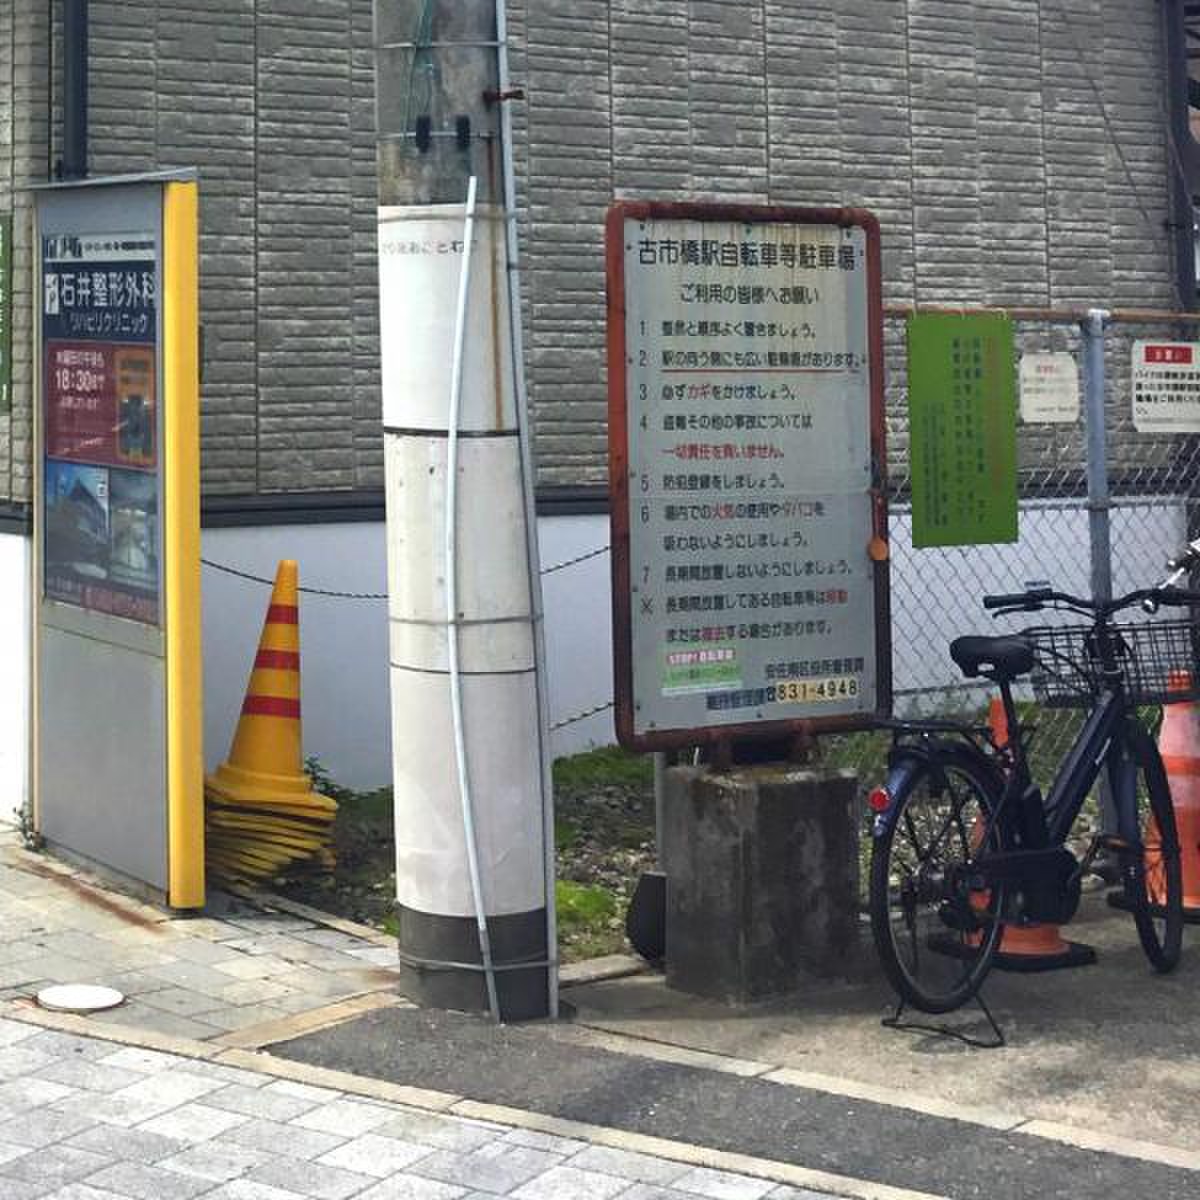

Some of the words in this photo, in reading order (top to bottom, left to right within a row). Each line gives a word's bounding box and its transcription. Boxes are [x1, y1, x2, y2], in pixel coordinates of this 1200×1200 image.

[639, 238, 856, 271] 古市橋駅自転車等駐車場
[61, 271, 156, 308] 石井整形外科
[680, 284, 819, 305] ご利用の皆様へお願い
[639, 321, 646, 337] 1
[639, 351, 648, 368] 2
[639, 384, 648, 400] 3
[639, 415, 647, 431] 4
[777, 679, 858, 701] 831-4948
